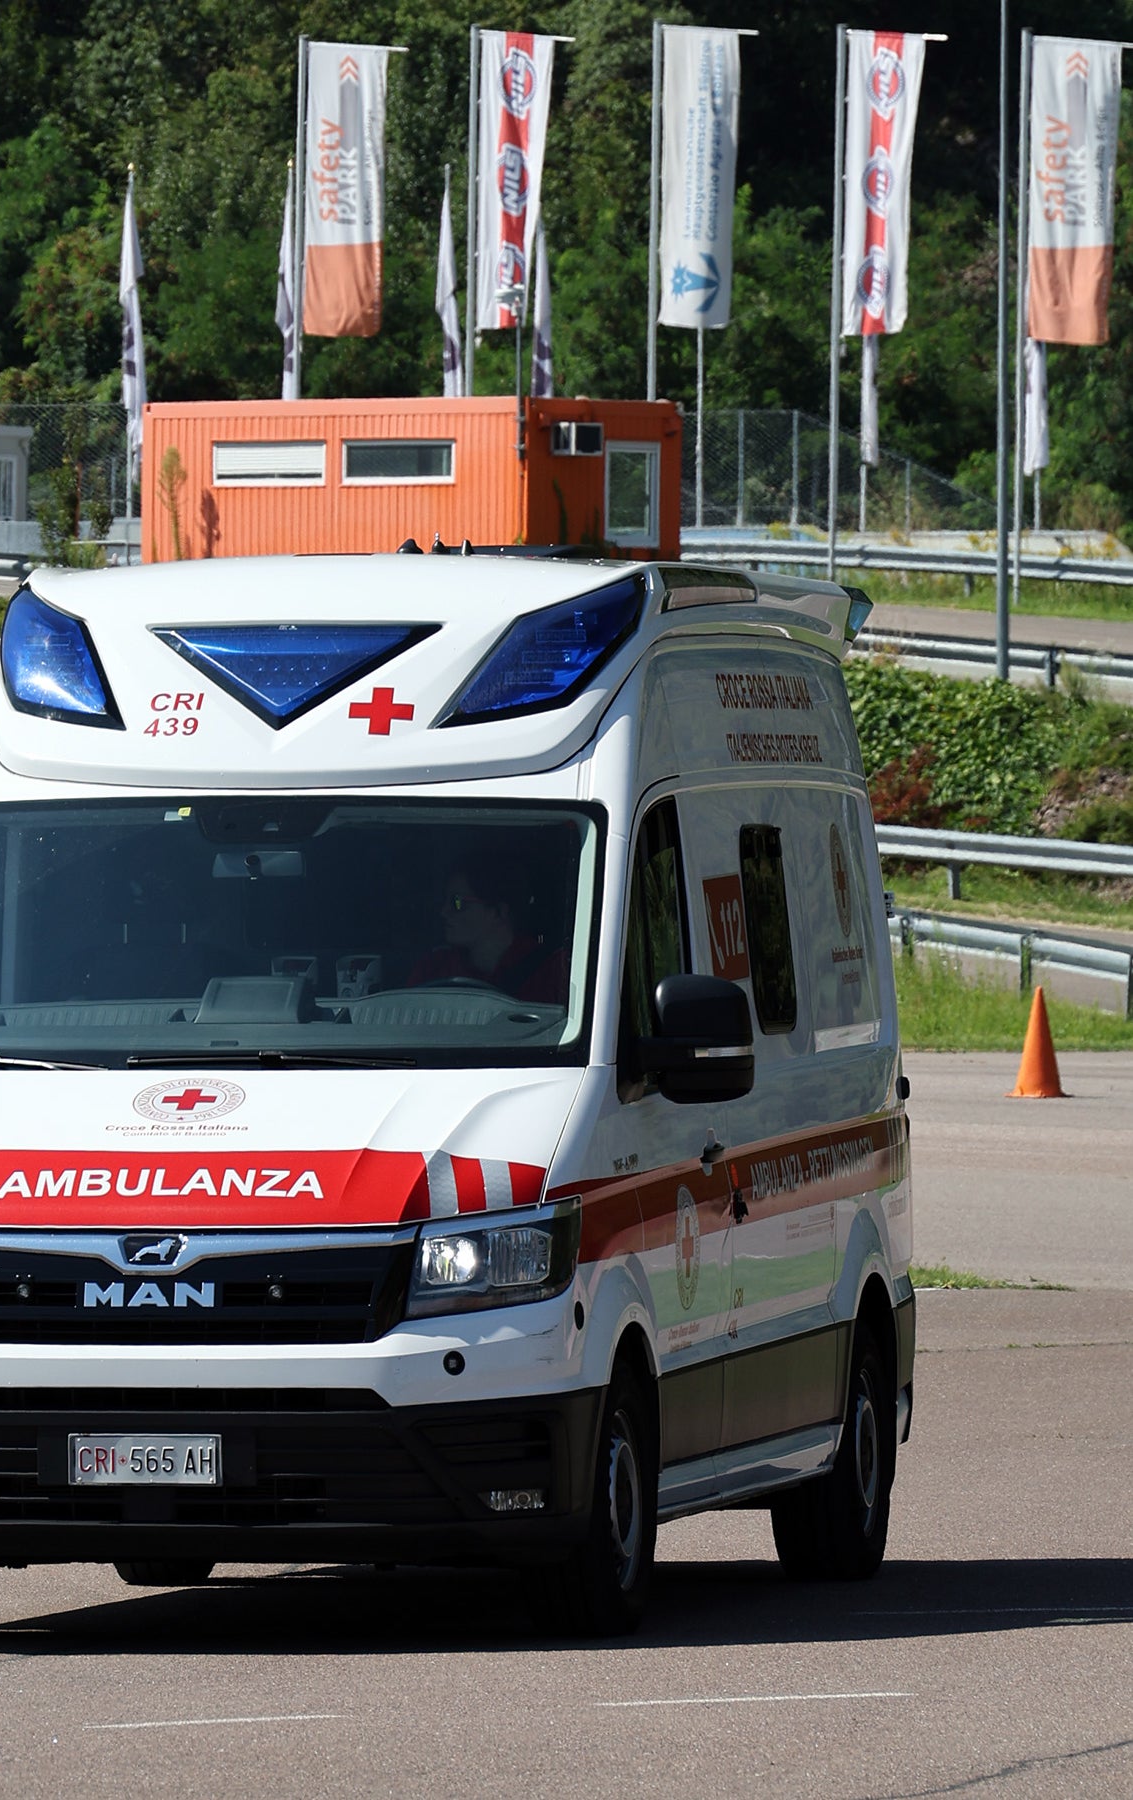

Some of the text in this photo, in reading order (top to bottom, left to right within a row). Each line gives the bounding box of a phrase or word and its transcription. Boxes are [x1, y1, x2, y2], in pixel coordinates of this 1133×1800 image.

[312, 117, 344, 222] safety
[338, 146, 357, 224] PARK
[502, 146, 523, 213] NILS
[1036, 115, 1072, 223] safety
[1064, 145, 1086, 226] PARK
[150, 692, 205, 711] CRI
[715, 673, 750, 709] CROCE
[745, 673, 777, 709] ROSSA
[143, 717, 199, 737] 439
[720, 898, 745, 957] 112
[105, 1124, 146, 1132] Croce
[750, 1153, 805, 1201] AMBULANZA
[83, 1282, 215, 1308] MAN
[78, 1446, 213, 1474] CRI 565 AH
